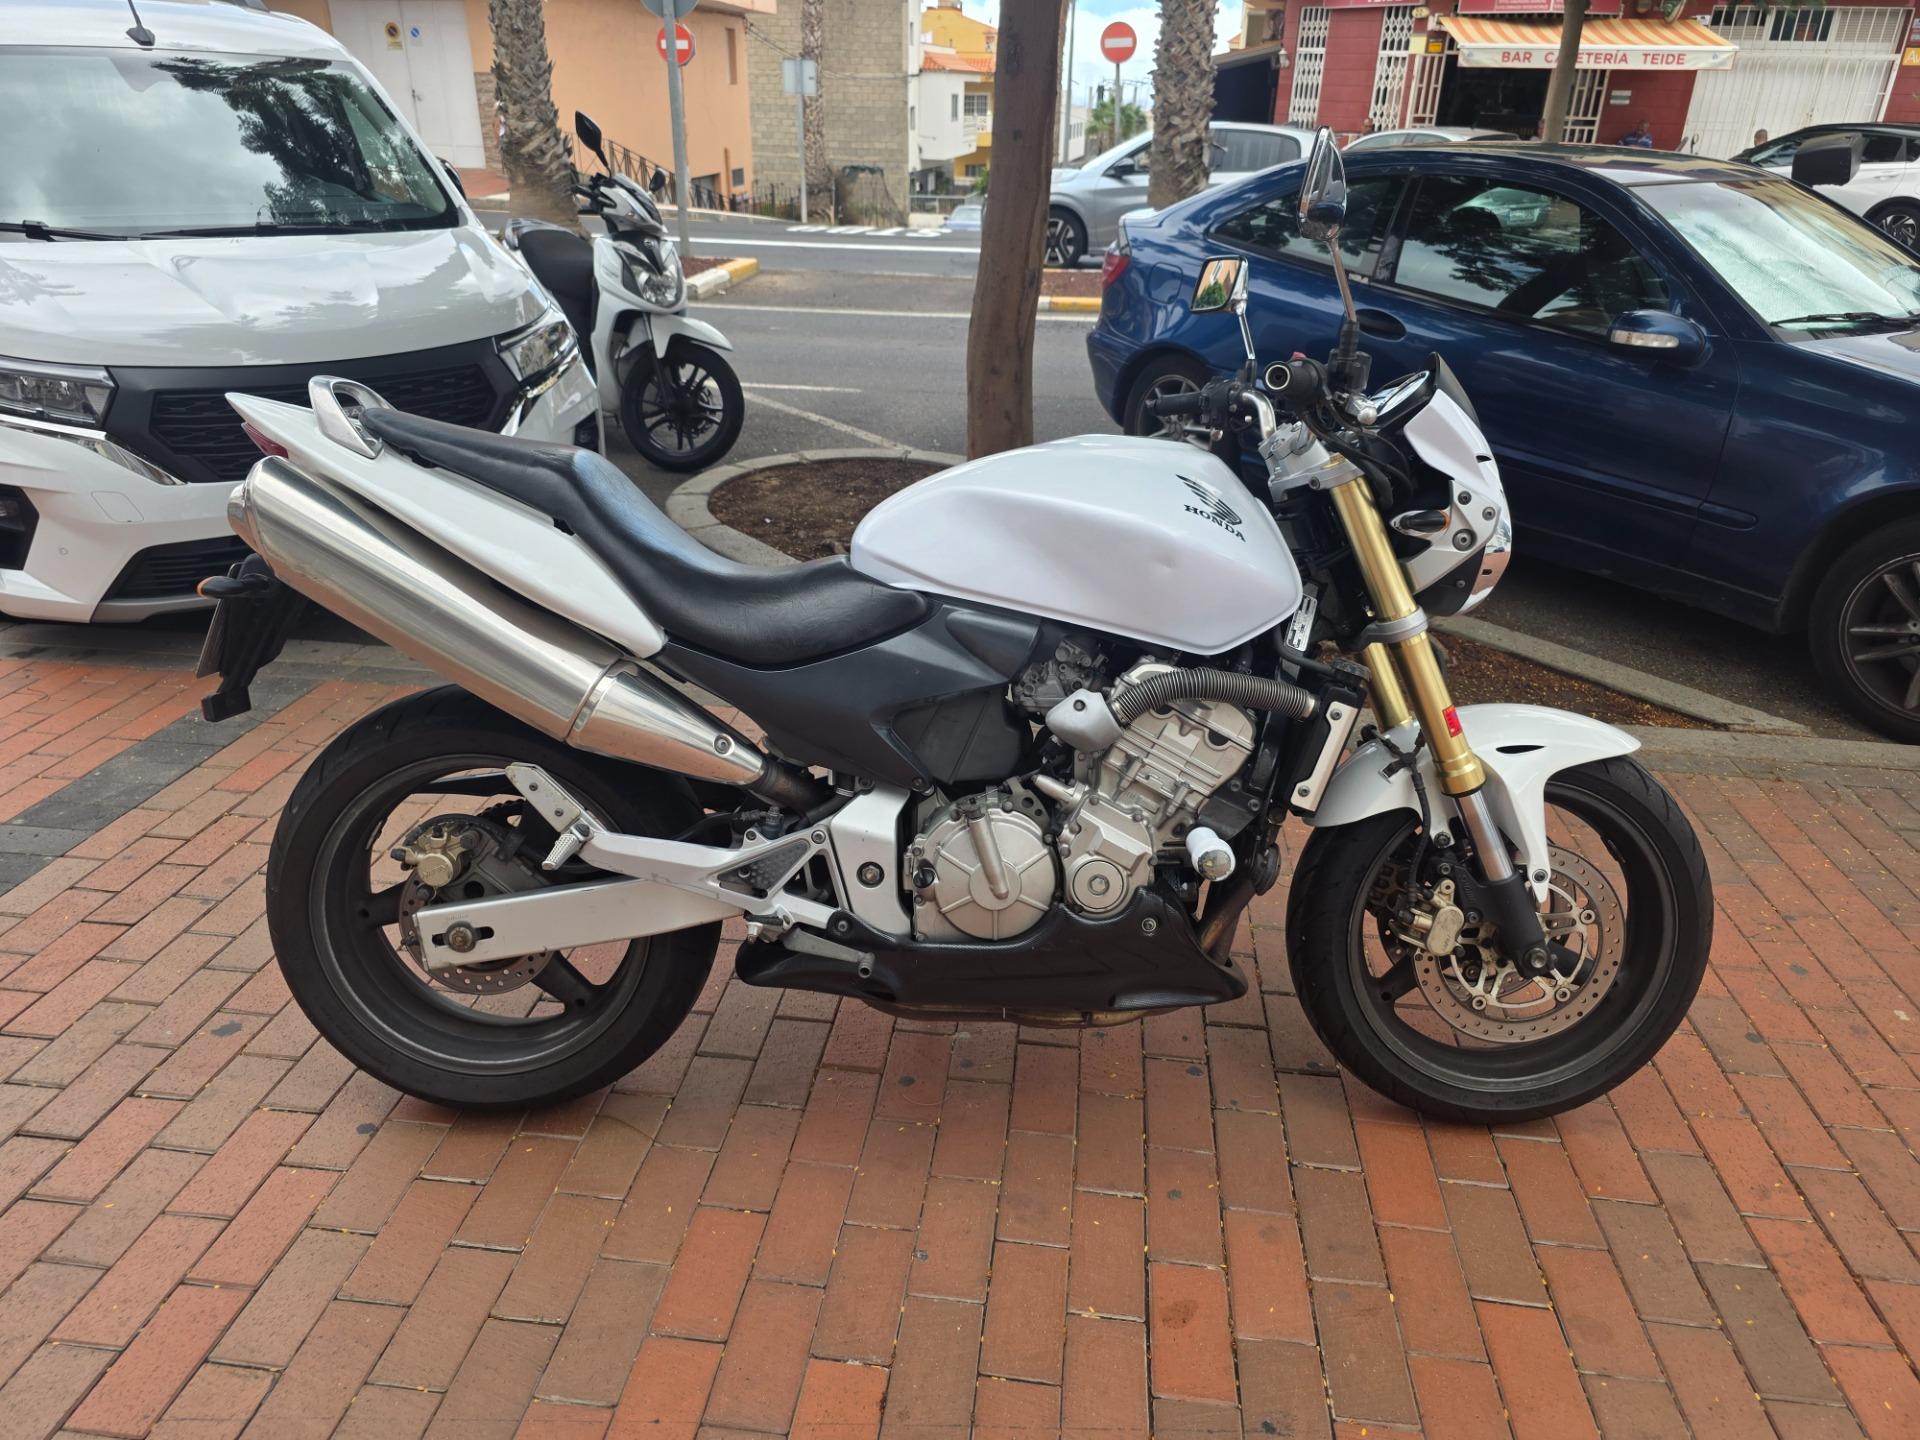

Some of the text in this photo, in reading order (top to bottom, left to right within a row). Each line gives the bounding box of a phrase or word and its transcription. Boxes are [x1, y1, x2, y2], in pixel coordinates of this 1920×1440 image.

[1501, 50, 1687, 65] BAR CETERÍA TEIDE
[1183, 504, 1246, 542] HONDA
